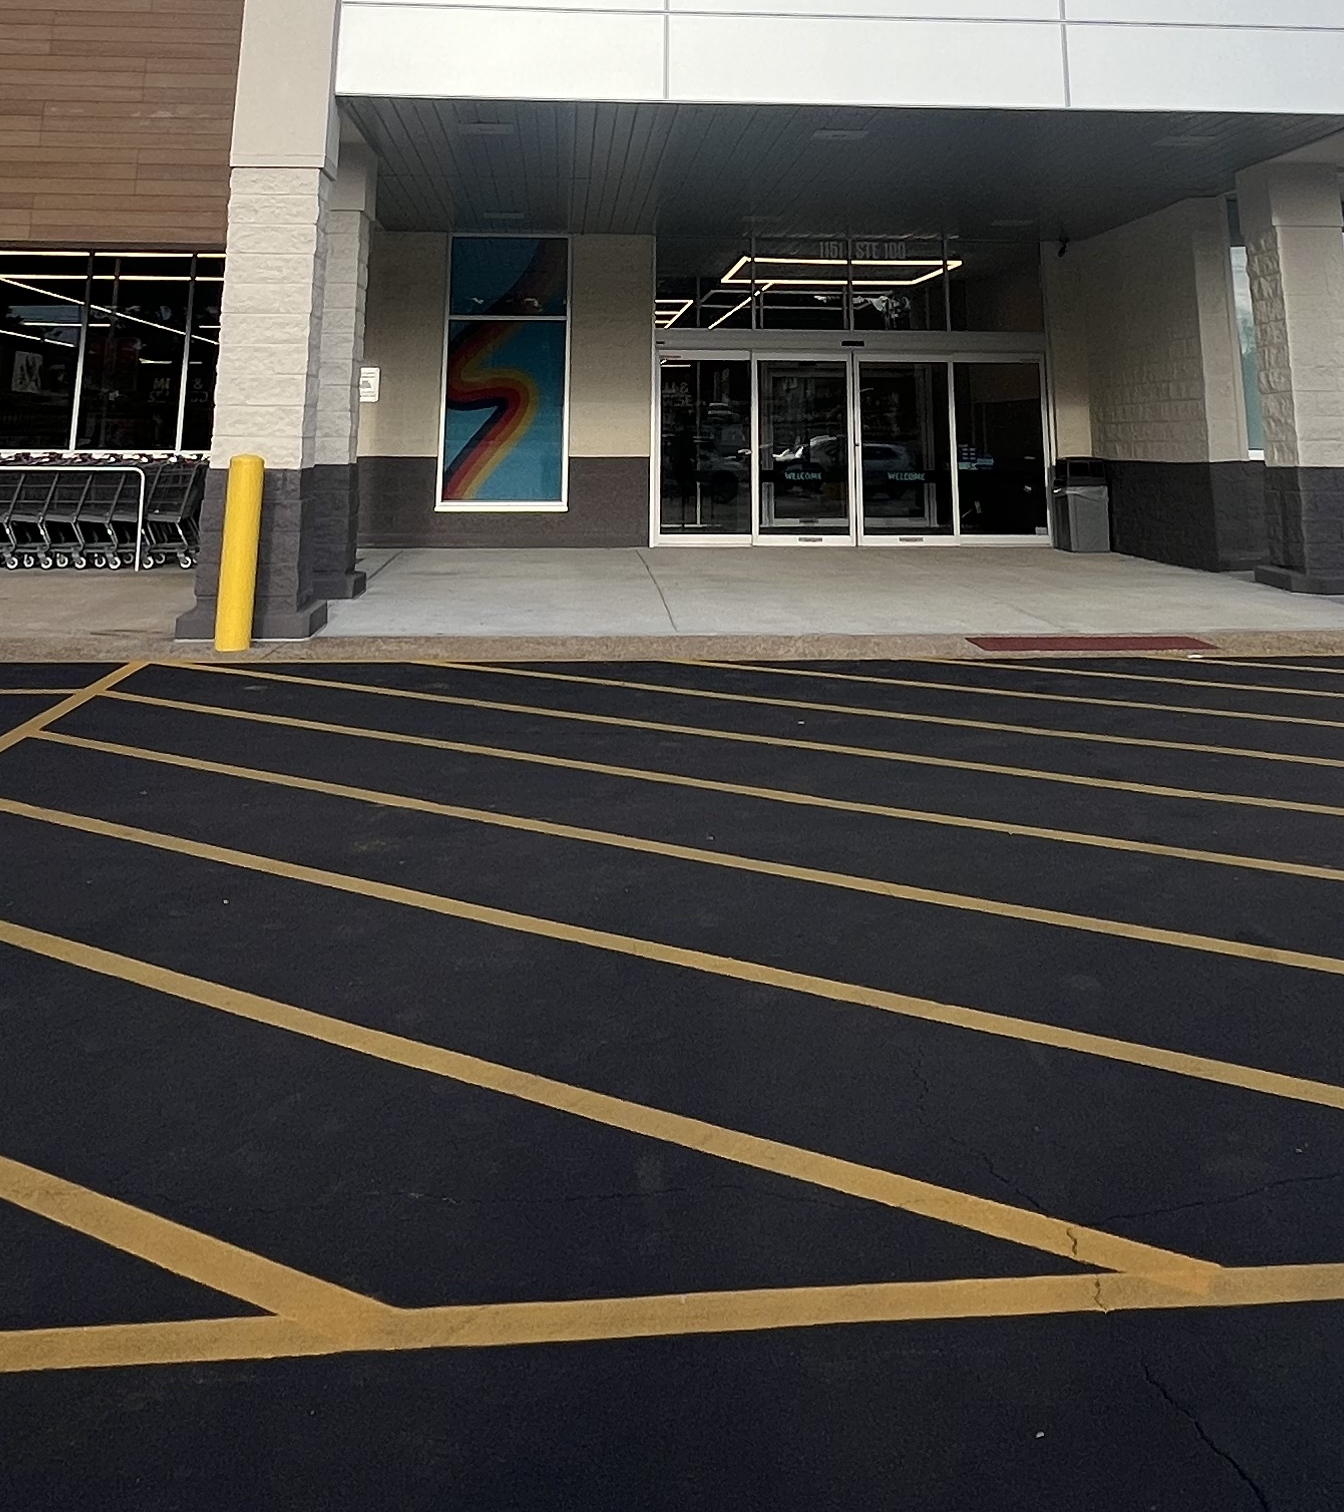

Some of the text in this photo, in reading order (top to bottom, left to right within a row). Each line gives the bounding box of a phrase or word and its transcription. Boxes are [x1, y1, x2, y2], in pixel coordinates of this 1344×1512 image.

[856, 242, 879, 259] STE
[784, 471, 822, 481] WELCOME
[887, 471, 926, 481] WELCOME
